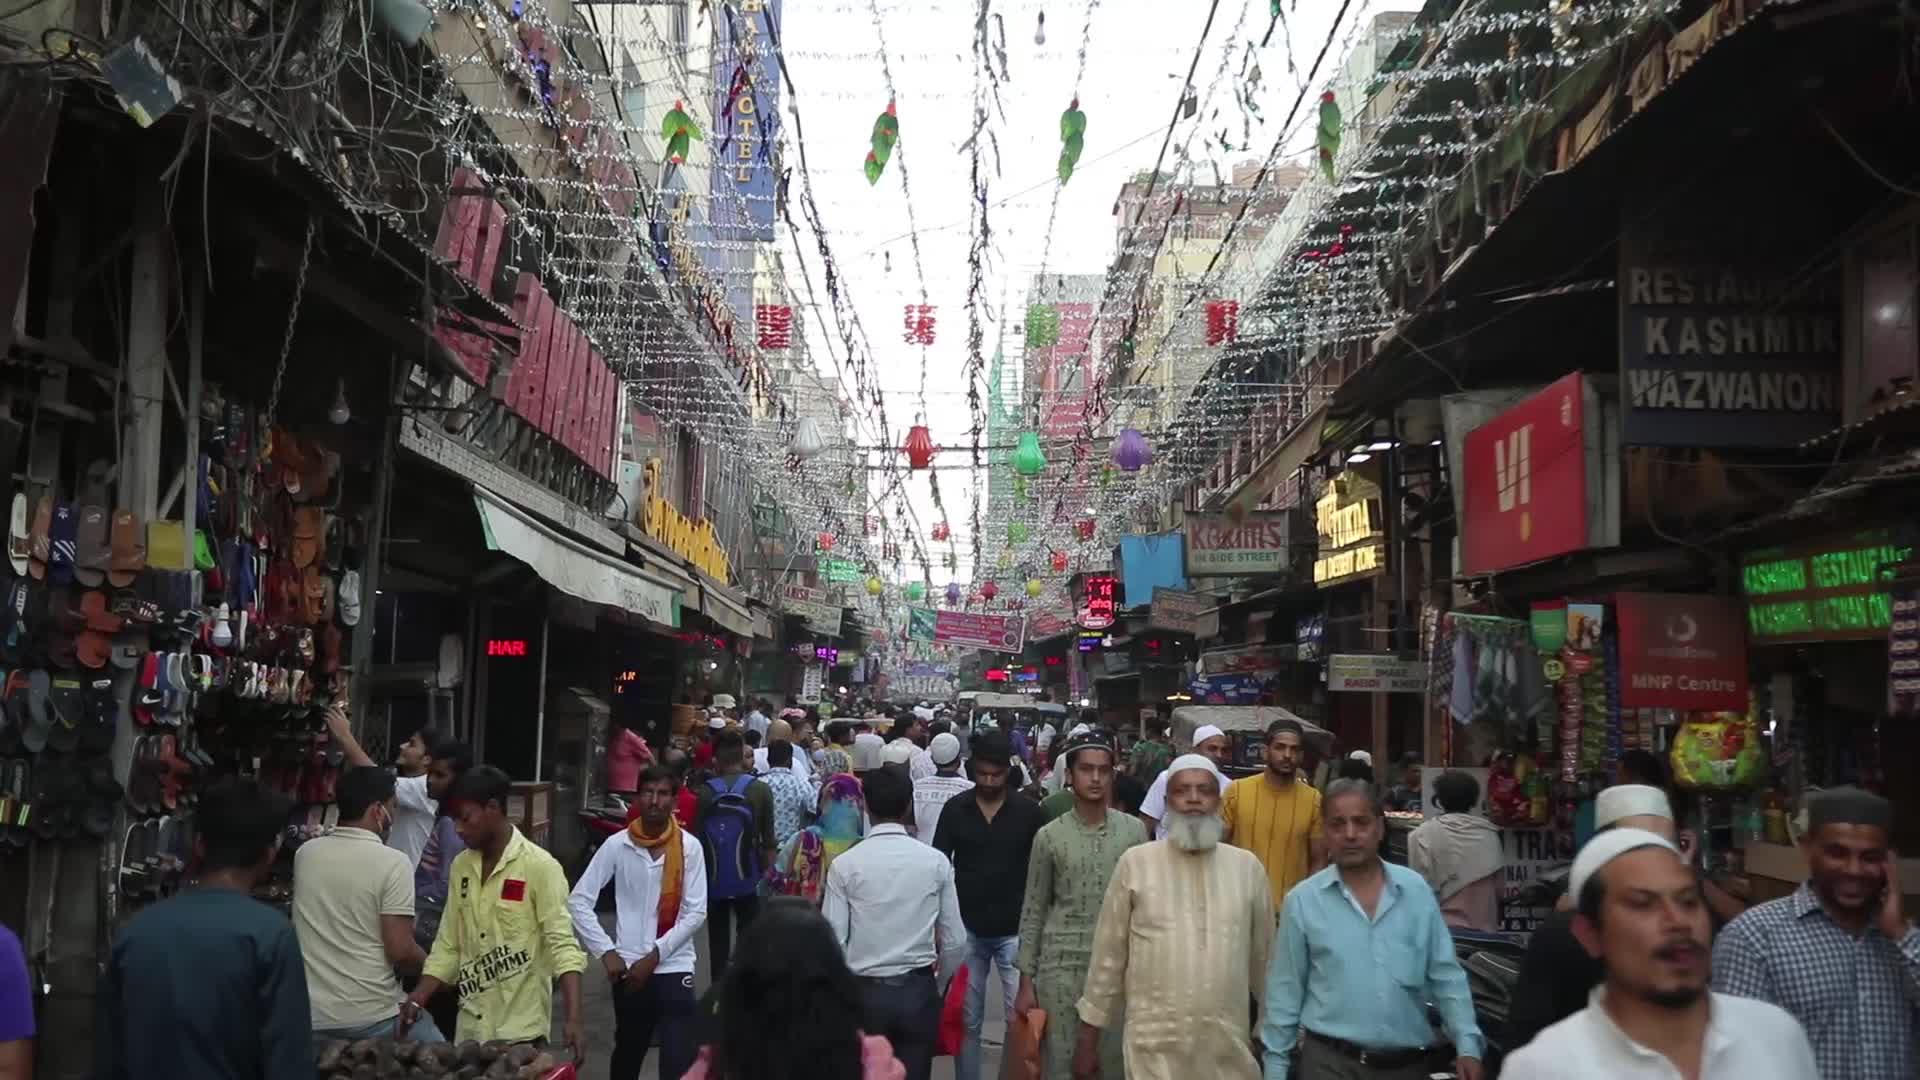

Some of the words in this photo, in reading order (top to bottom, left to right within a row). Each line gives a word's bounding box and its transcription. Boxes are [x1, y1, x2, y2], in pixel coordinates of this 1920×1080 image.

[737, 76, 757, 182] OTEL
[1237, 551, 1280, 562] STREET
[487, 640, 526, 656] HAR
[1632, 674, 1672, 690] MNP
[1677, 675, 1736, 692] Centre
